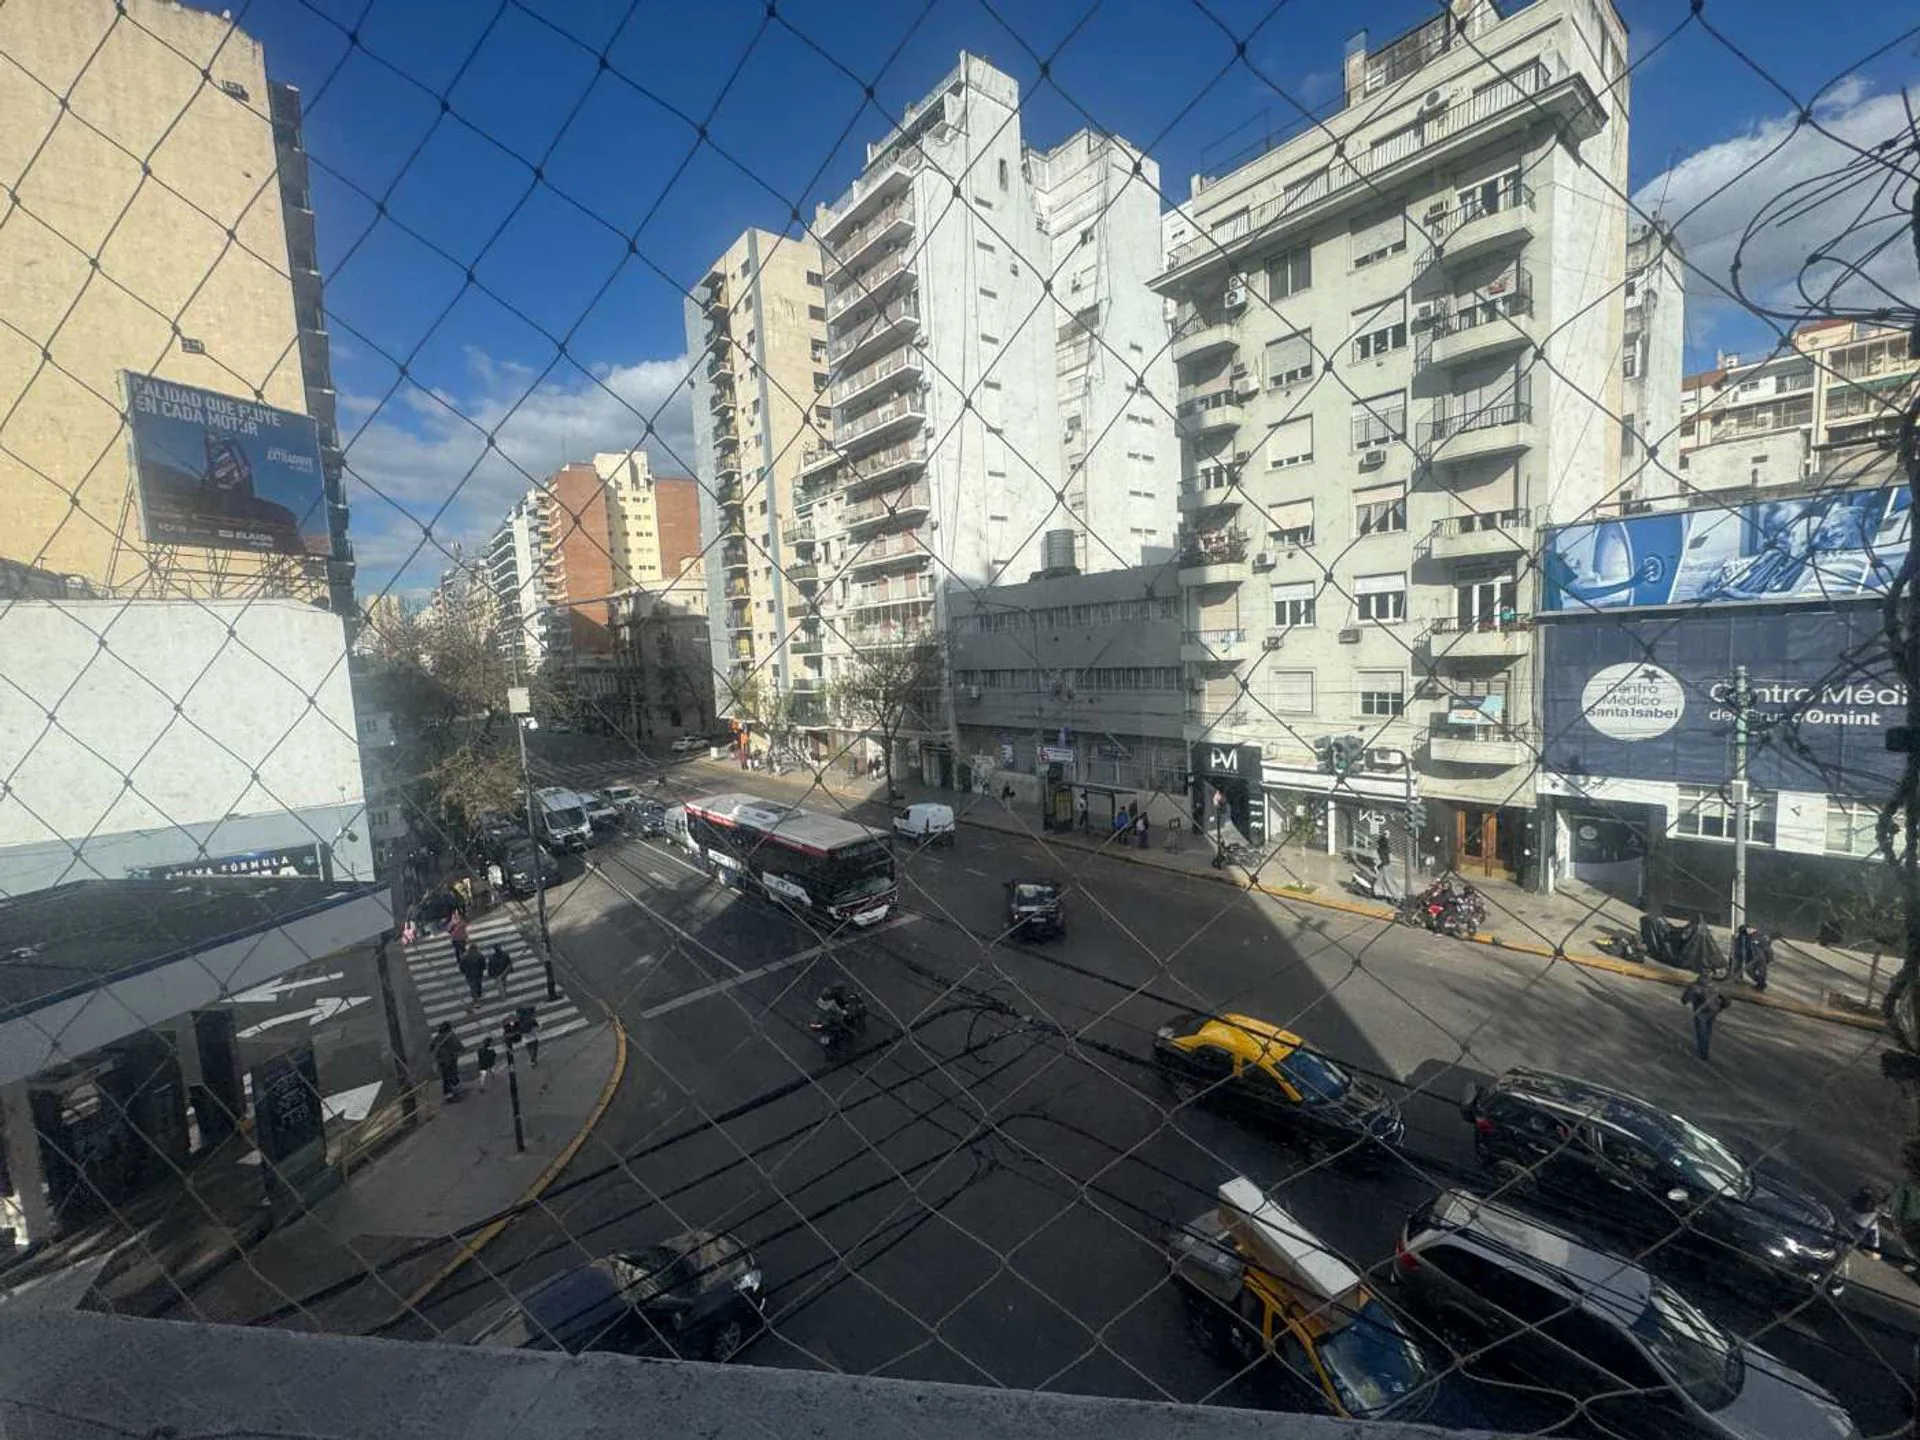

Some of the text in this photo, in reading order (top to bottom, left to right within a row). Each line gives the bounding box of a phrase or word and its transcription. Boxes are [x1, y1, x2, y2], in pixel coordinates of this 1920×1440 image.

[133, 377, 281, 428] CALIDAD QUE FLUYE
[135, 394, 259, 437] EN CADA MOTOR
[1606, 682, 1658, 694] Centro
[1710, 682, 1909, 706] Cntro Médi
[1747, 709, 1804, 725] Gruo
